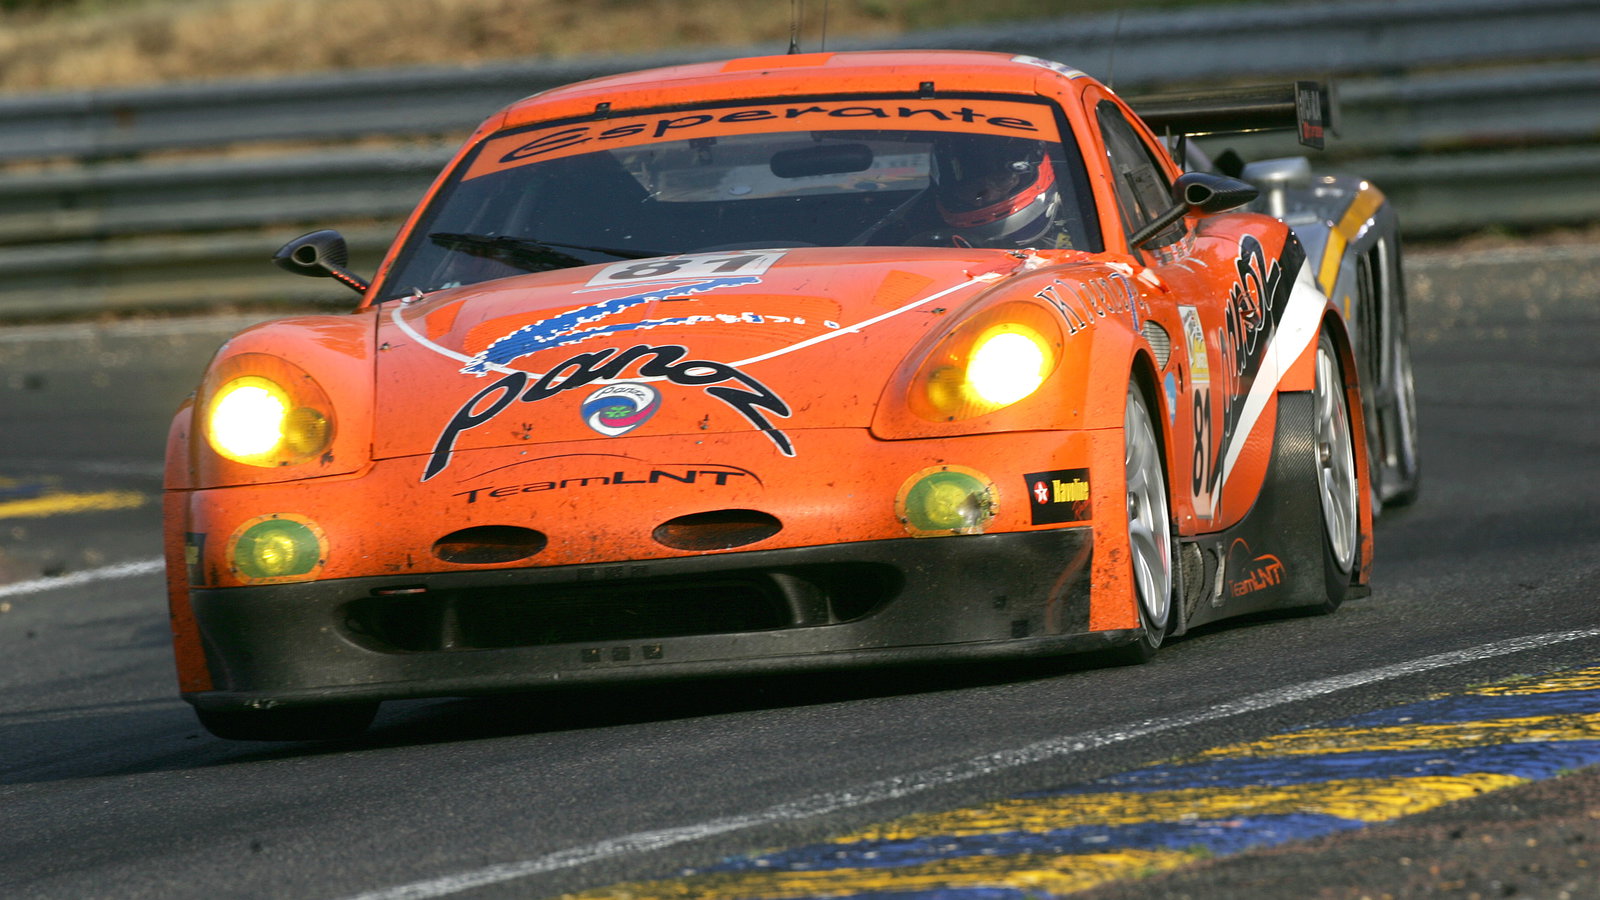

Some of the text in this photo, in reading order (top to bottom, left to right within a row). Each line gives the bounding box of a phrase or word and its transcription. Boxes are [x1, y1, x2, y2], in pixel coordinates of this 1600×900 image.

[498, 105, 1040, 164] Esperante
[608, 254, 765, 280] 81
[1192, 387, 1211, 498] 81
